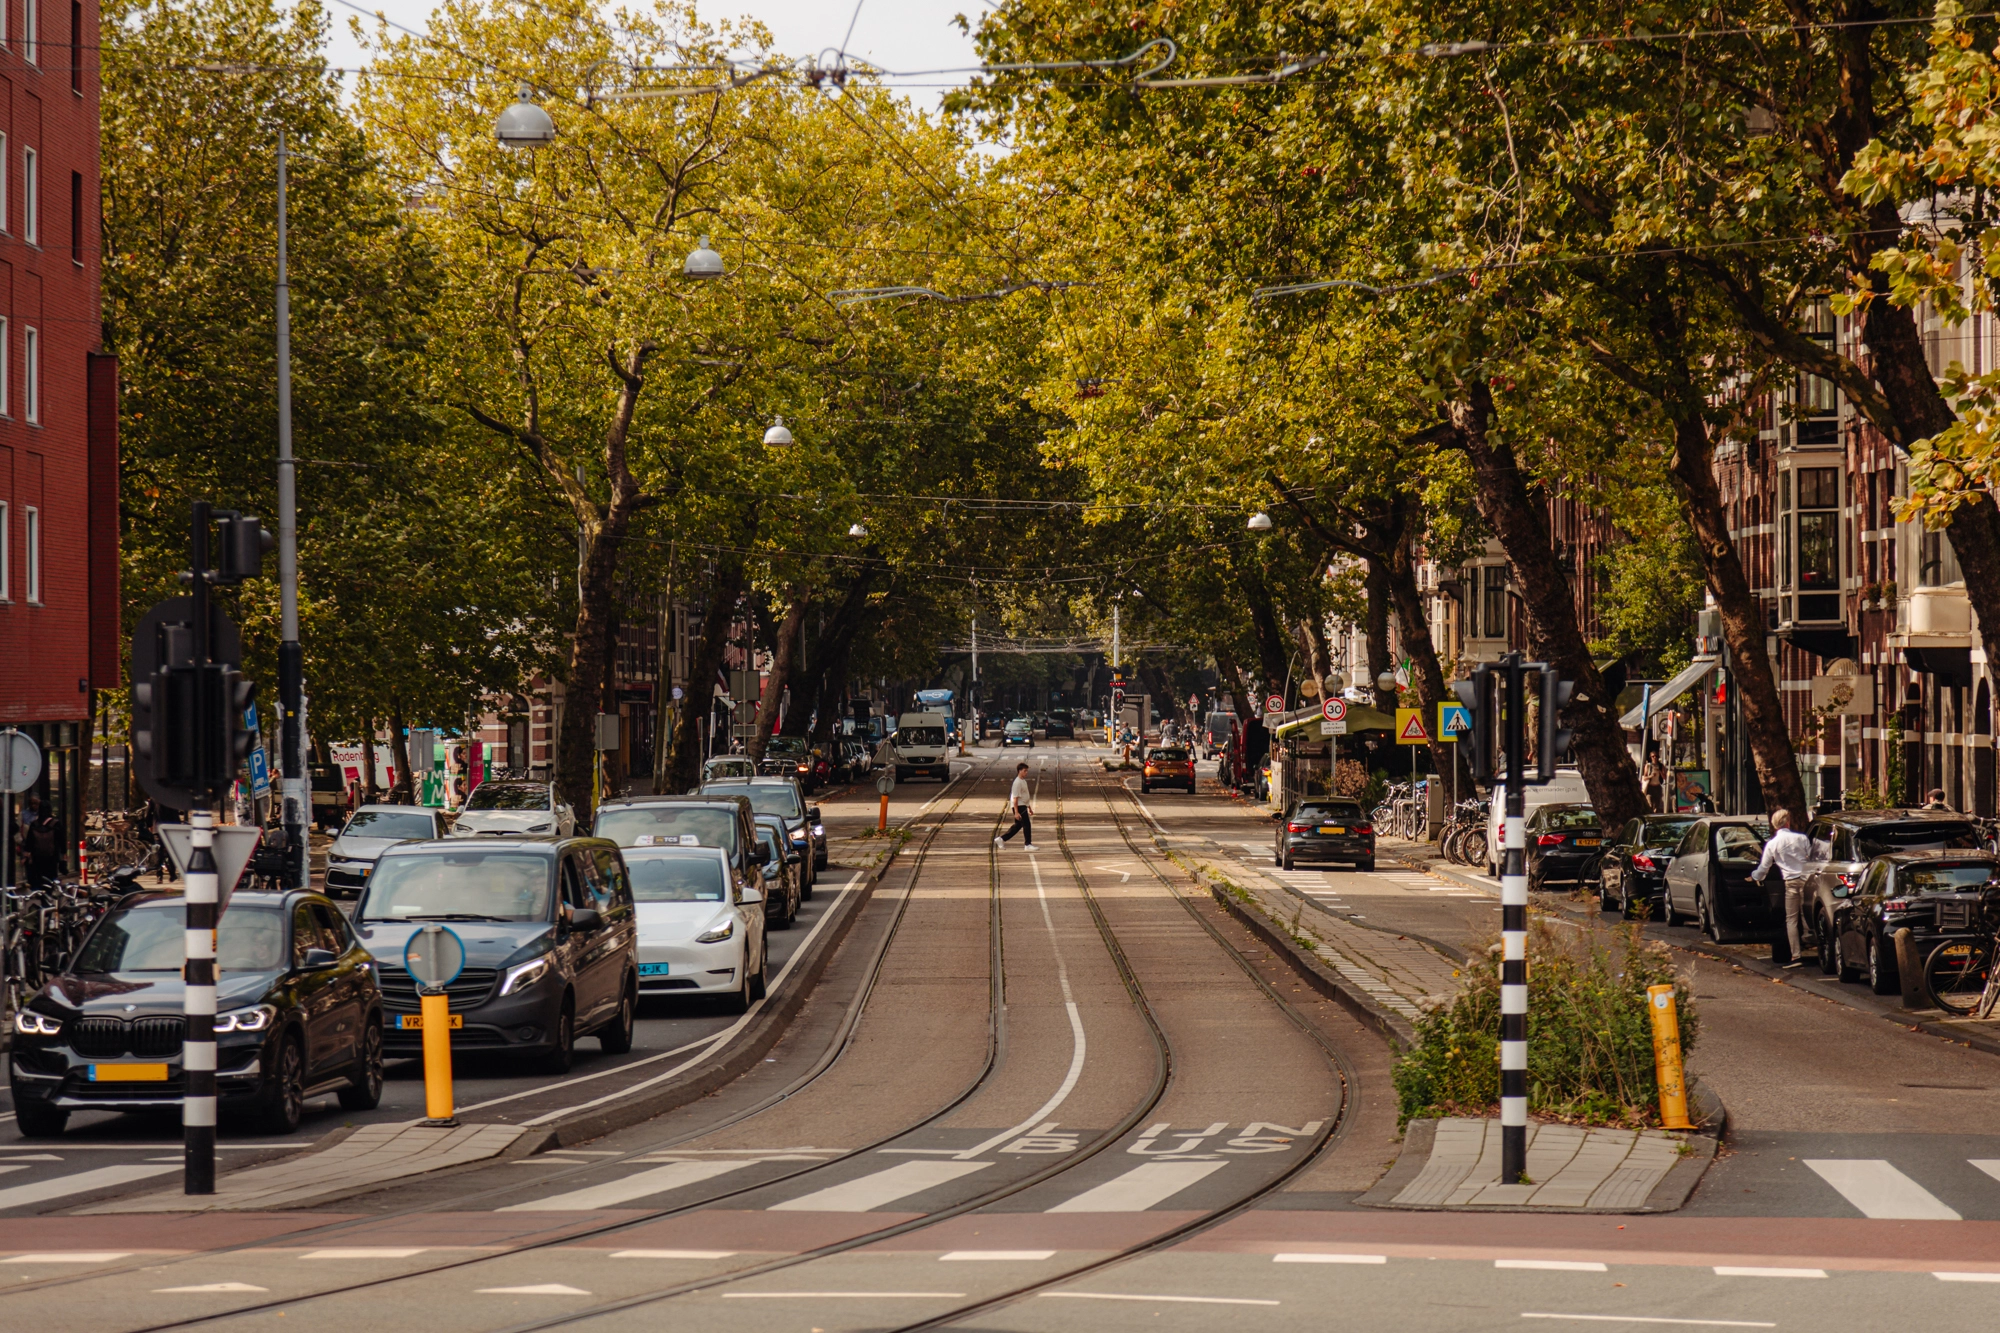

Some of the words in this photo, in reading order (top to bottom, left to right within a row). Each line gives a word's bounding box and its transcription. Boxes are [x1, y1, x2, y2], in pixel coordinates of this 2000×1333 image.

[1327, 705, 1342, 714] 30
[253, 753, 263, 774] P
[998, 1136, 1294, 1155] BUS
